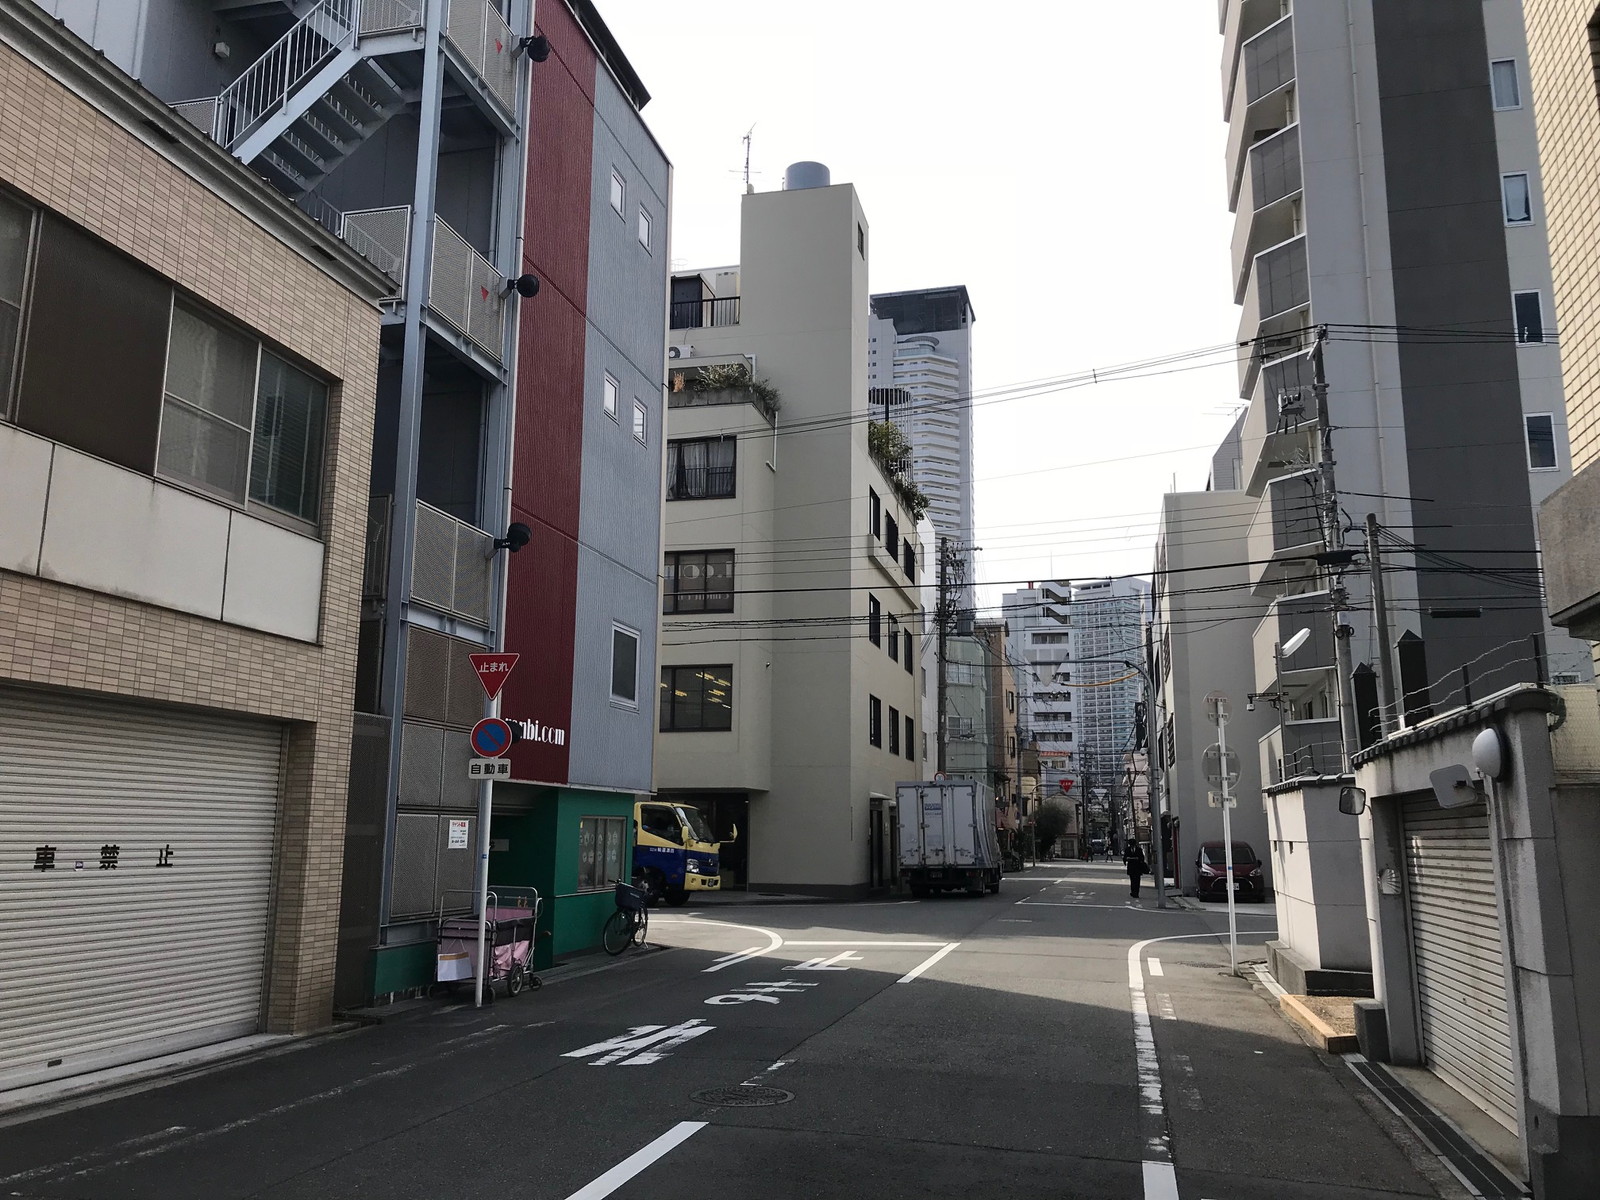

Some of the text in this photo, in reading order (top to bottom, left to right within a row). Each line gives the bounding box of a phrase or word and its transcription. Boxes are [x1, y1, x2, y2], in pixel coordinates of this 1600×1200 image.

[479, 661, 508, 673] 止まれ
[471, 763, 508, 775] 自動車
